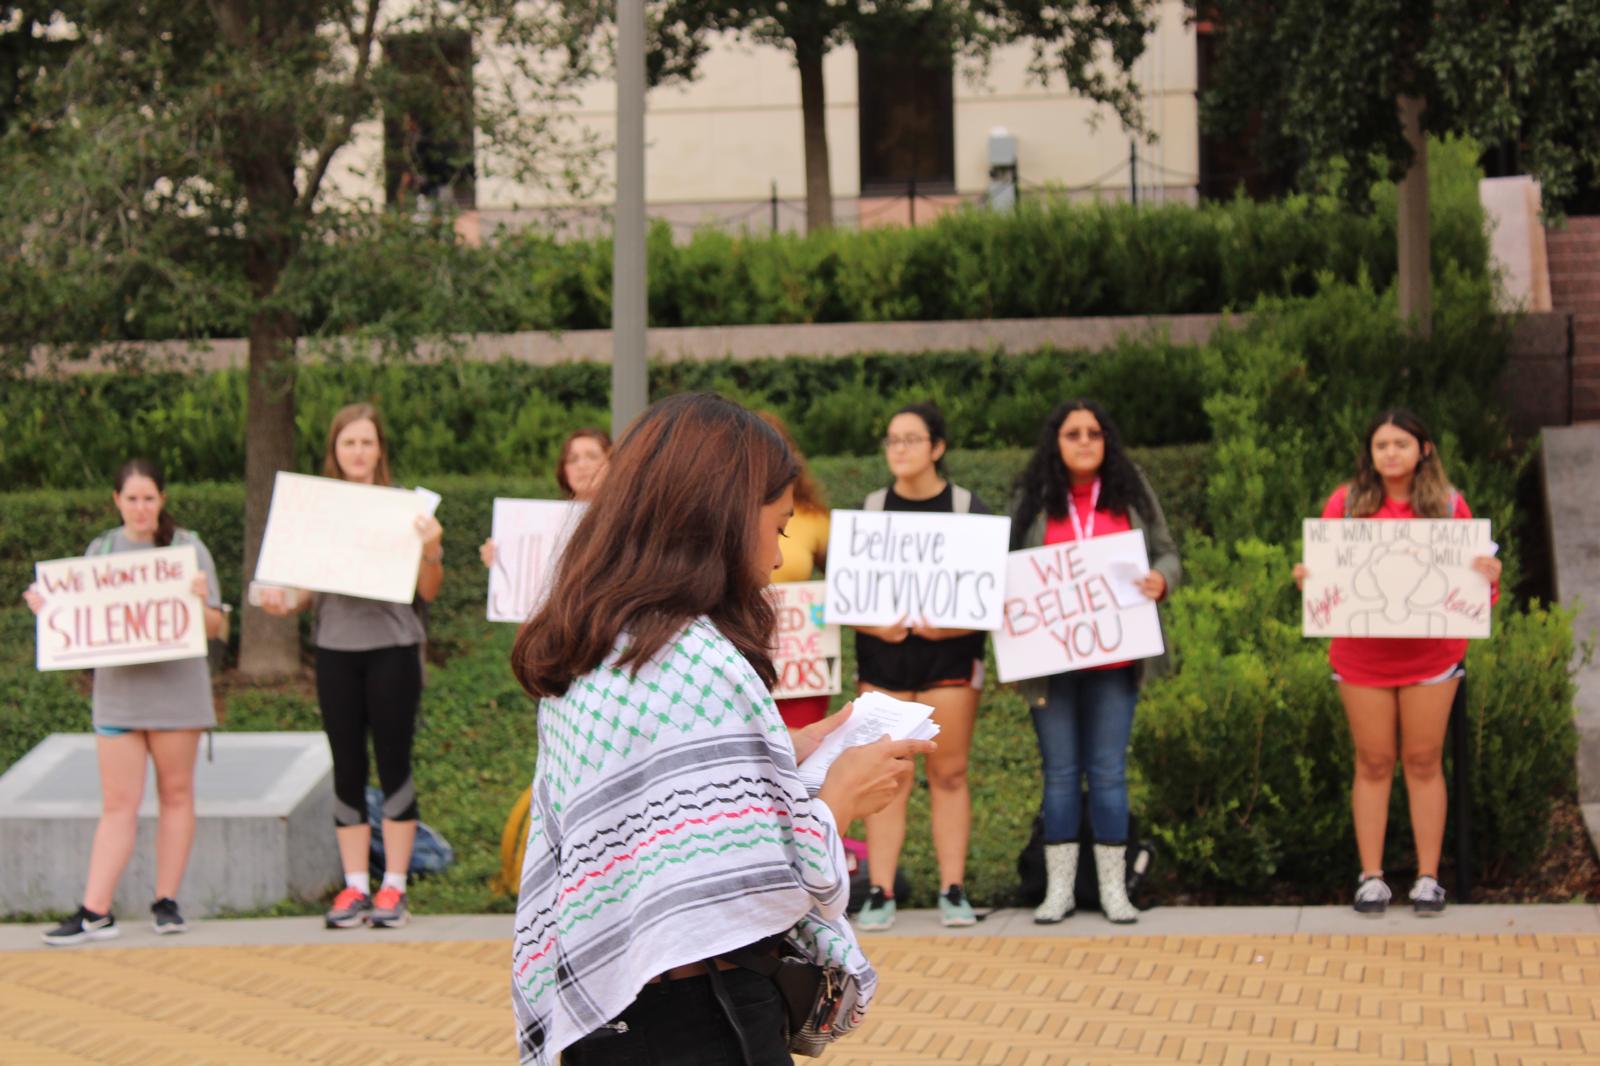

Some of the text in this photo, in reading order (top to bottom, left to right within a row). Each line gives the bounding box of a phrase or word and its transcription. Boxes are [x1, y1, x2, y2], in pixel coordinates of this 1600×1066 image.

[849, 515, 945, 564] believe
[43, 567, 84, 594] WE
[1030, 546, 1086, 587] WE
[834, 567, 995, 620] survivors
[48, 597, 190, 649] SILENCED
[1050, 614, 1123, 662] YOU
